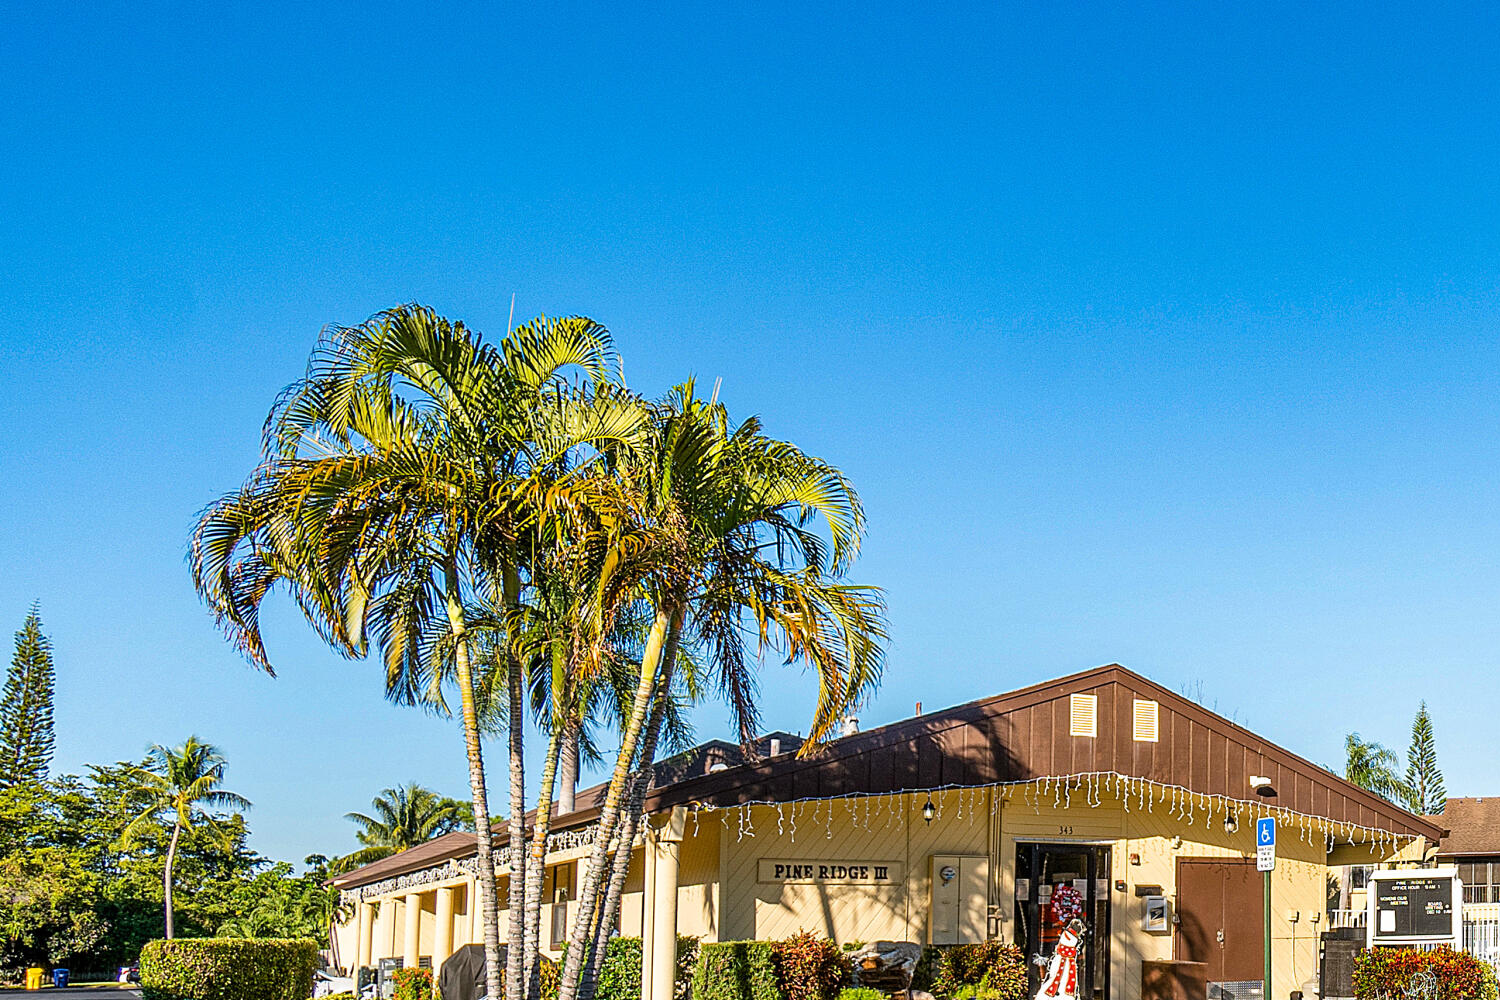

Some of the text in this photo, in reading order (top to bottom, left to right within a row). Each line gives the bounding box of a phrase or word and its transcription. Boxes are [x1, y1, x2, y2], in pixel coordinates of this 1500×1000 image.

[1059, 825, 1073, 835] 343
[774, 864, 888, 880] PINE RIDGE III
